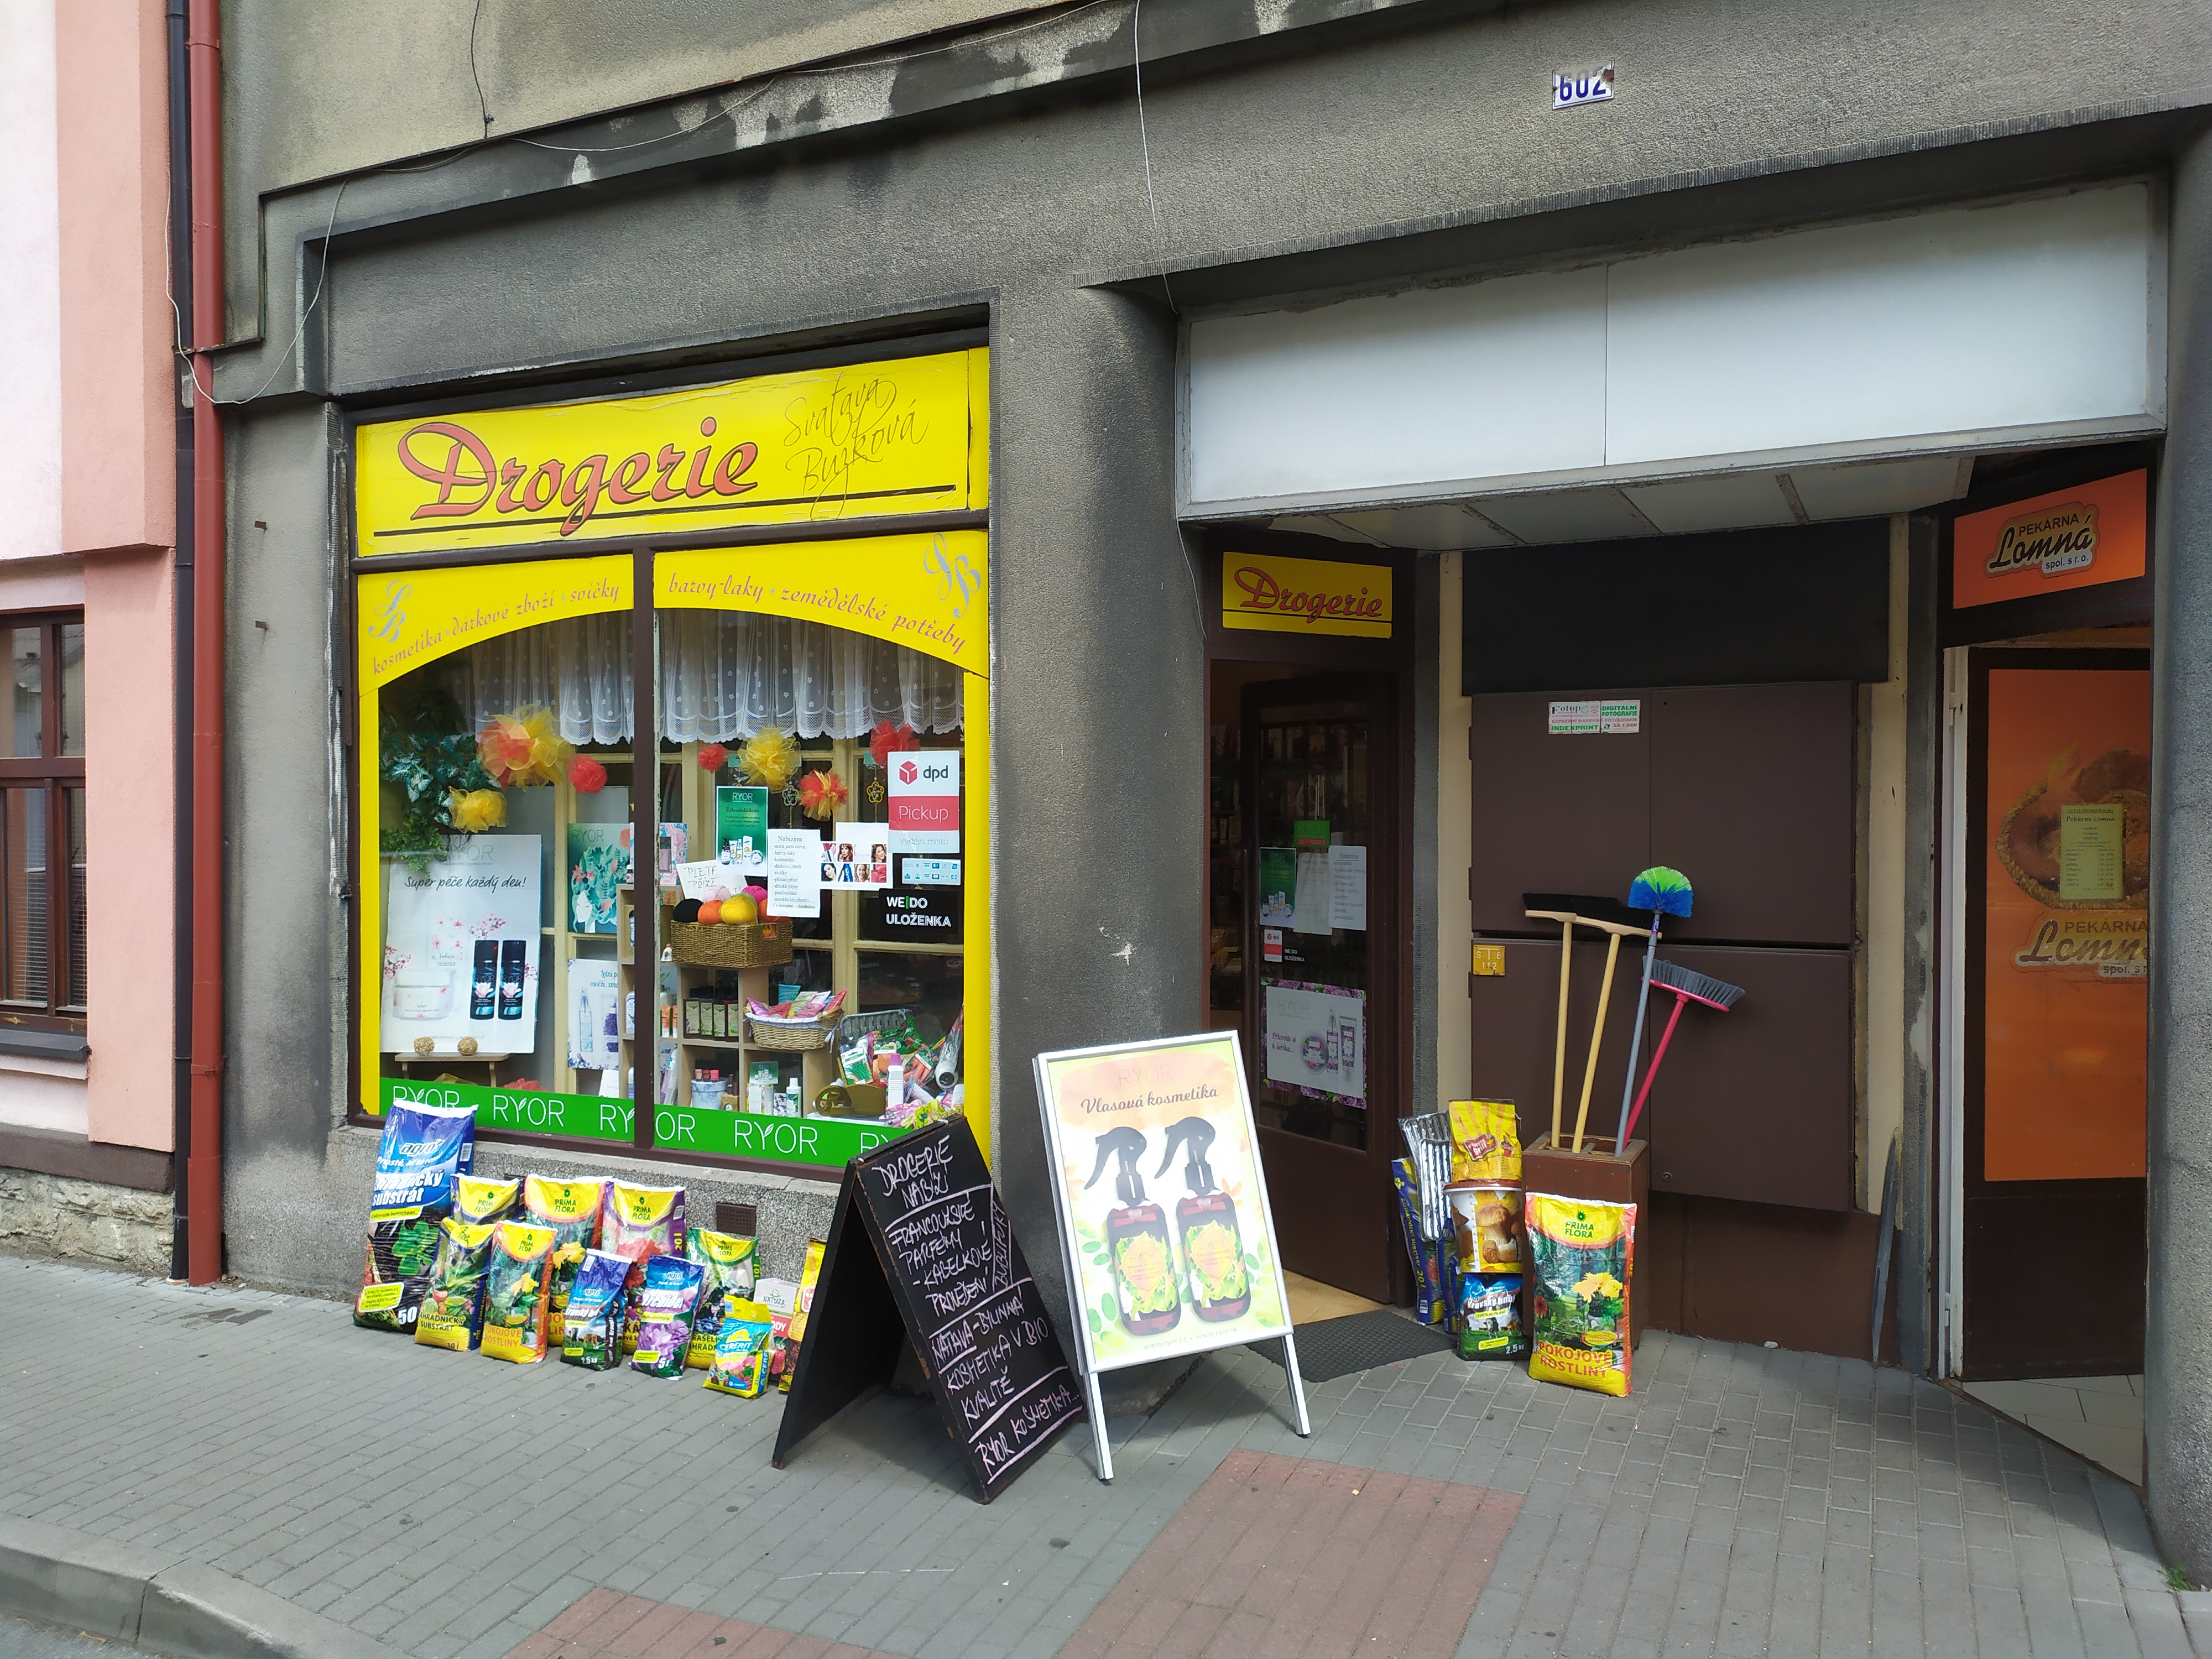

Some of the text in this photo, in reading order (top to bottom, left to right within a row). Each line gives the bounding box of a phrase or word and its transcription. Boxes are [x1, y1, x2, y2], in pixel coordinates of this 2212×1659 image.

[1559, 66, 1606, 101] 602
[784, 372, 891, 447] Svatava
[397, 416, 758, 536] Drogerie
[2018, 513, 2079, 537] PEKÁRNA
[1989, 514, 2093, 569] Lomná
[2046, 557, 2065, 570] spol.
[1234, 566, 1383, 624] Drogerie
[373, 577, 620, 675] kosmetika dárkové zboží svíčky
[780, 587, 888, 621] zemědělské
[891, 614, 966, 655] potřeby
[922, 765, 948, 782] dpd
[732, 792, 753, 801] RYOR
[899, 806, 949, 823] Pickup
[572, 829, 604, 842] RYOR
[927, 837, 948, 845] místo
[404, 877, 437, 891] Super
[436, 875, 463, 891] péče
[465, 874, 499, 894] každý
[885, 912, 952, 927] ULOŽENKA
[2064, 917, 2147, 933] PEKÁRNA
[2103, 966, 2130, 975] spol.
[1278, 998, 1310, 1015] RYOR
[1118, 1064, 1175, 1087] RYOR
[1081, 1084, 1219, 1115] Vlasová kosmetika
[493, 1094, 565, 1128] RYOR
[734, 1119, 818, 1156] RYOR
[400, 1142, 437, 1156] agro
[1473, 1143, 1488, 1156] grill
[372, 1186, 425, 1207] substrát
[633, 1205, 651, 1214] PRIMA
[1564, 1228, 1593, 1239] FLORA
[1565, 1220, 1594, 1230] PRIMA
[763, 1296, 785, 1306] NATURA
[398, 1306, 418, 1326] 50
[1021, 1317, 1049, 1345] BIO
[1143, 1326, 1238, 1350] www.ryor.cz www.ryor.sk
[719, 1342, 753, 1350] CERERIT
[1538, 1340, 1613, 1365] POKOJOVÉ
[658, 1358, 666, 1369] 5
[1540, 1355, 1606, 1378] ROSTLINY
[974, 1431, 1016, 1477] RYOR
